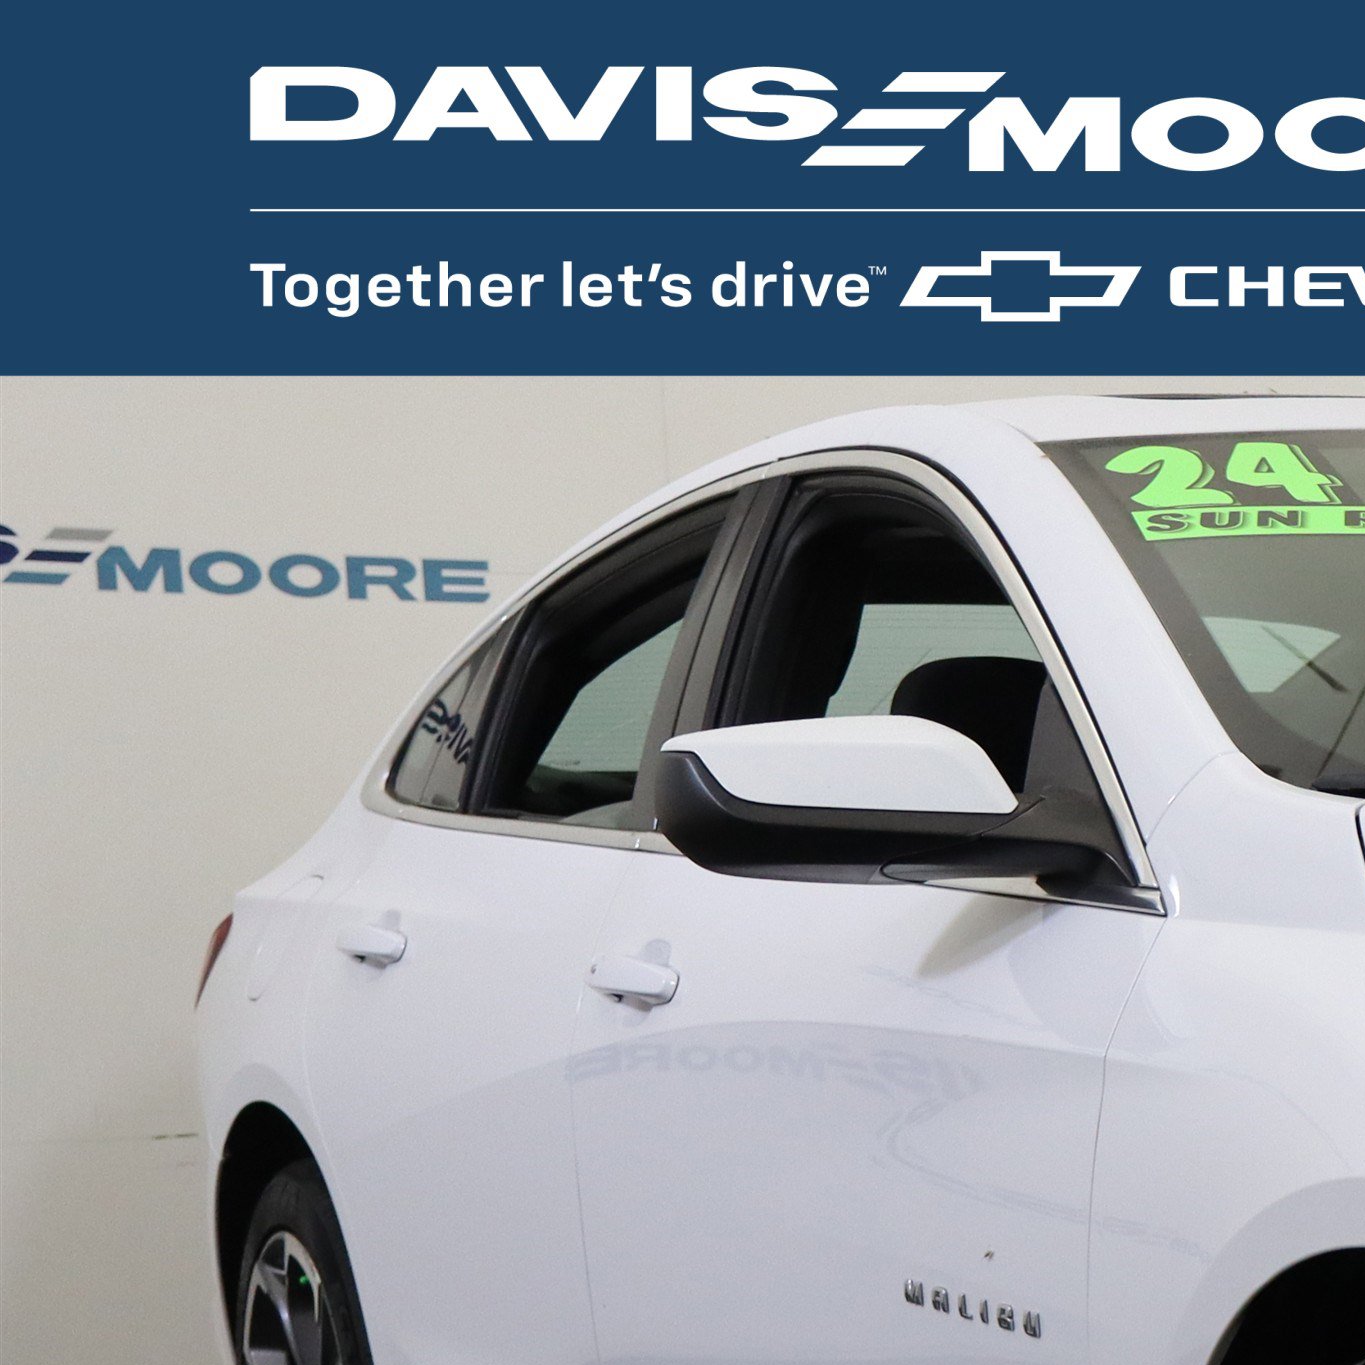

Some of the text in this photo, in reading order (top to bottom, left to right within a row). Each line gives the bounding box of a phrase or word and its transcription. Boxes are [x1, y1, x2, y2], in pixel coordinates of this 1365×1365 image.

[1104, 441, 1343, 508] 24
[1145, 510, 1305, 533] SUN
[96, 546, 490, 603] MOORE
[904, 1278, 1042, 1339] MALIBU
